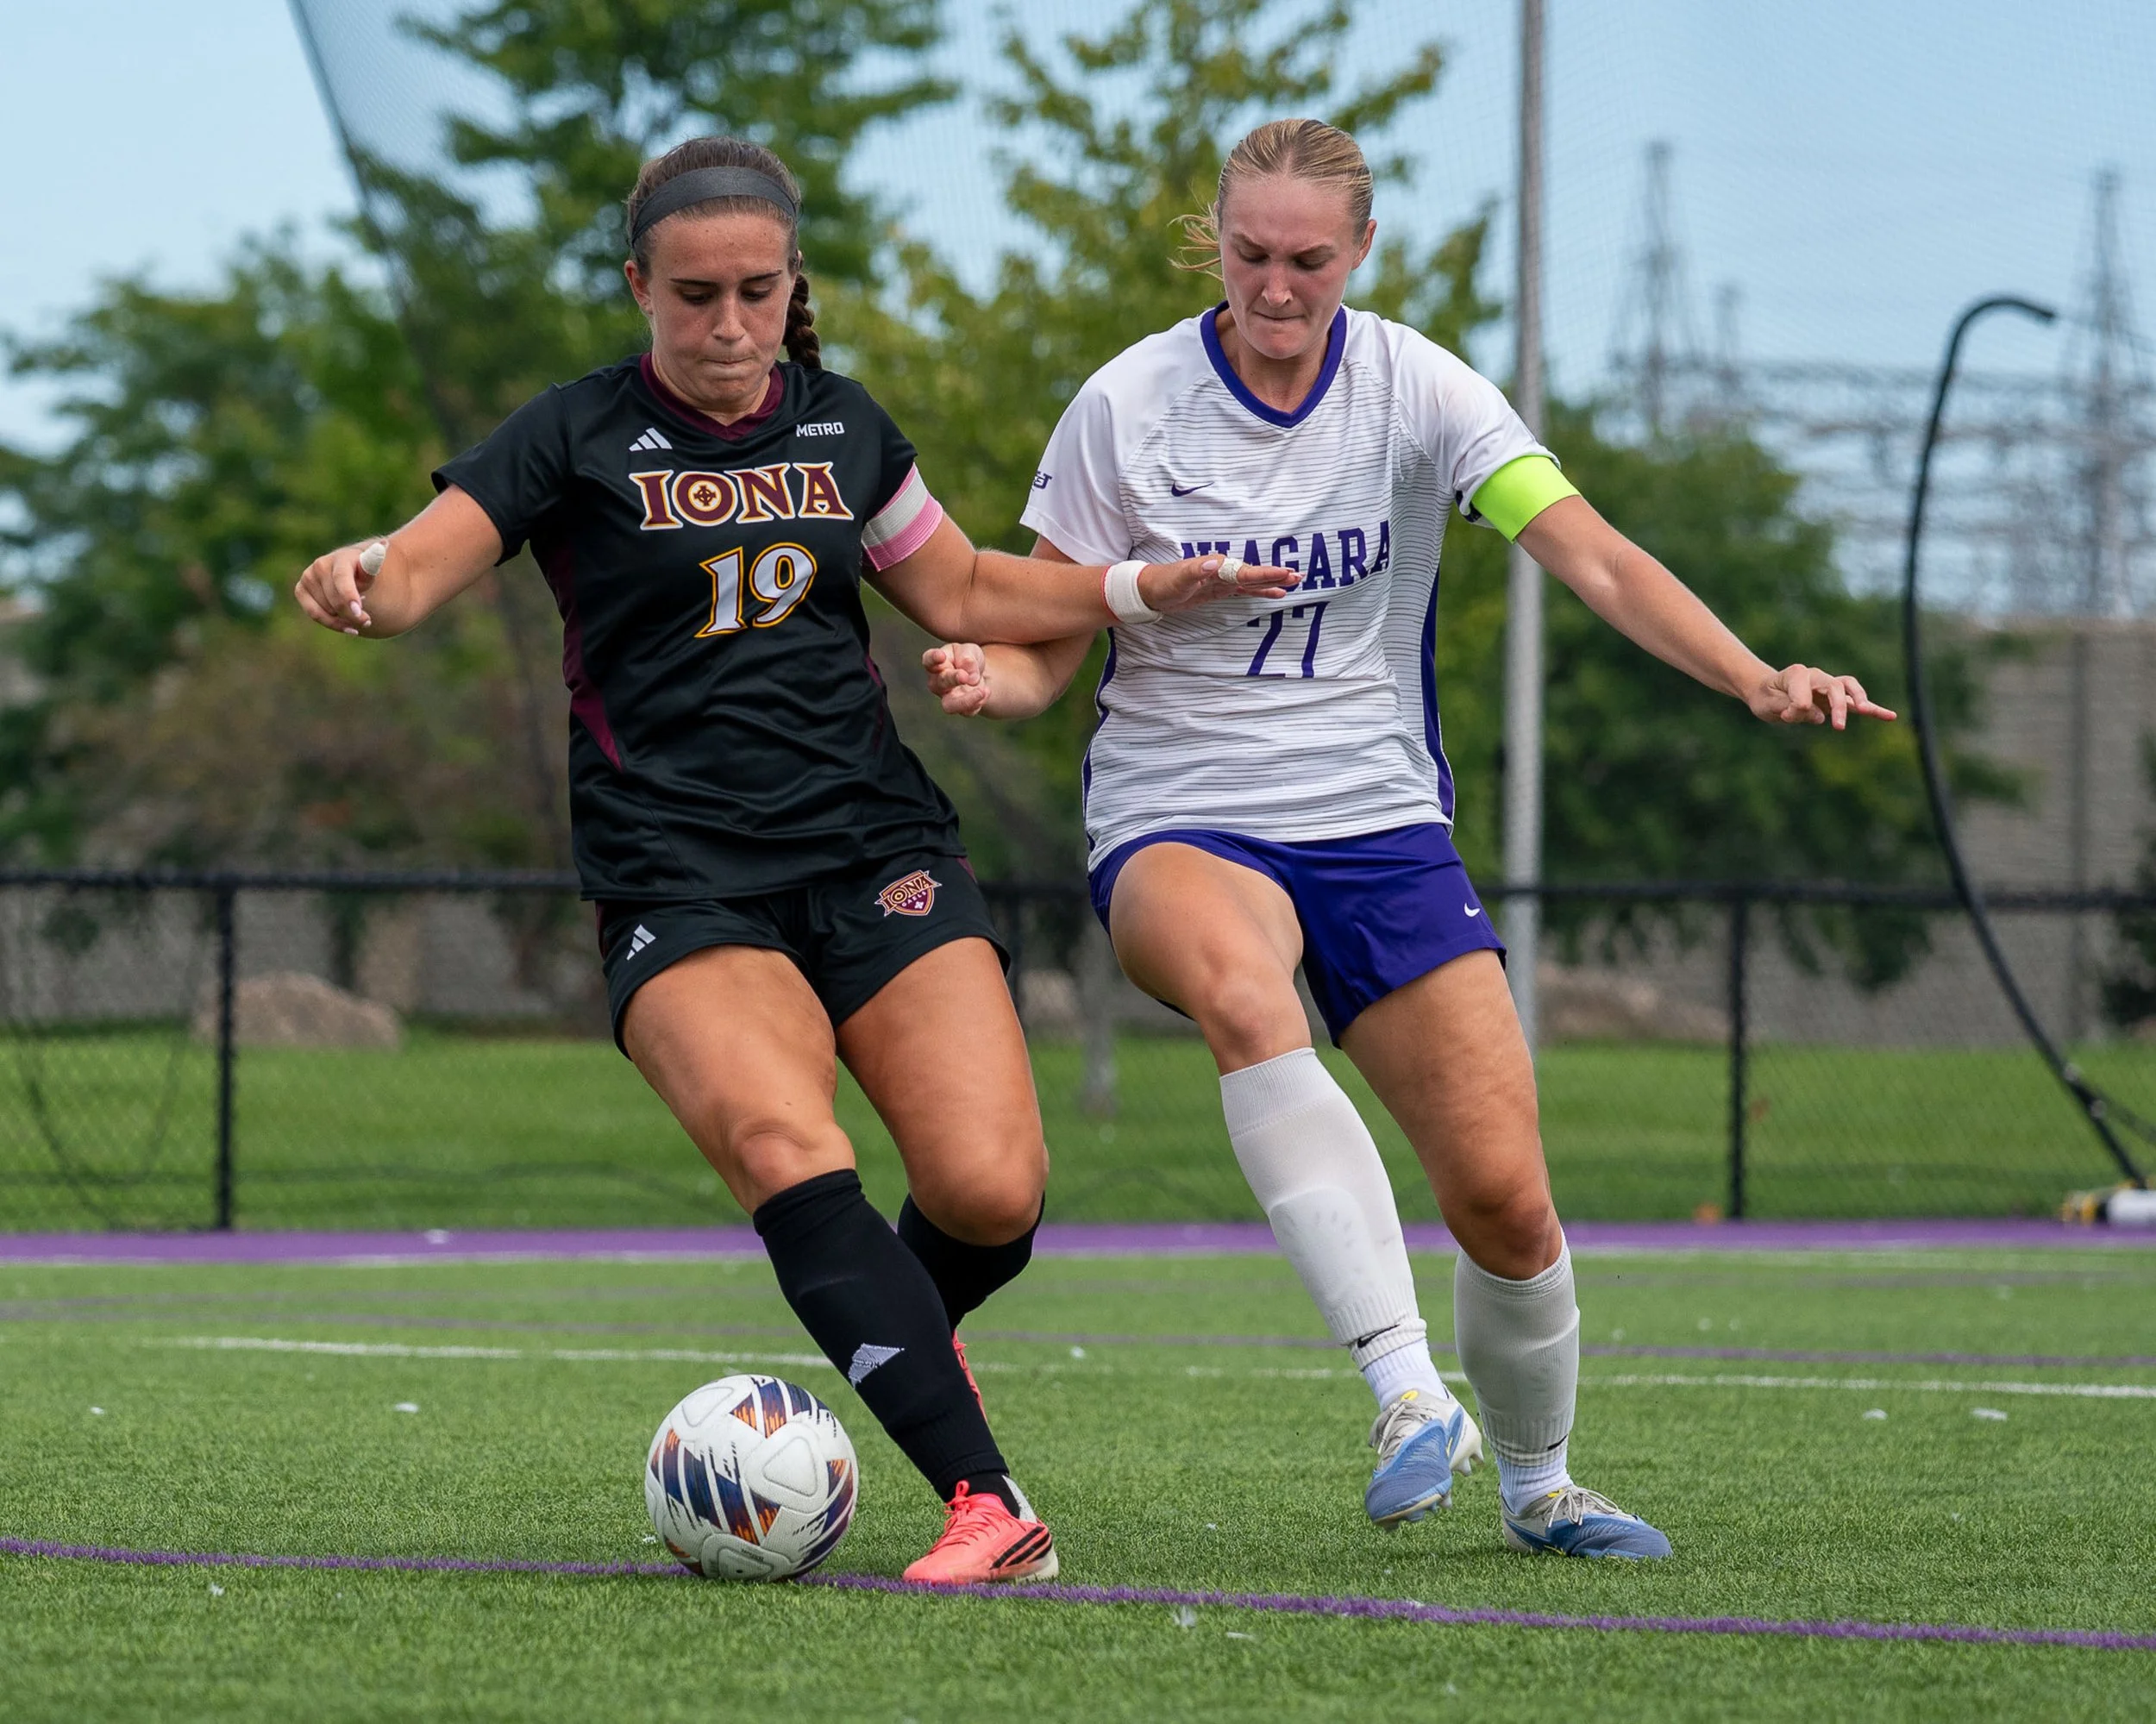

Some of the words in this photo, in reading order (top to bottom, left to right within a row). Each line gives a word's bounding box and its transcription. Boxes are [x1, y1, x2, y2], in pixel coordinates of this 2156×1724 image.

[796, 422, 845, 437] METRO
[629, 461, 855, 530] IONA
[693, 542, 818, 638] 19
[1181, 520, 1390, 592] AGARA
[1246, 601, 1331, 679] 27
[880, 874, 934, 912] IONA
